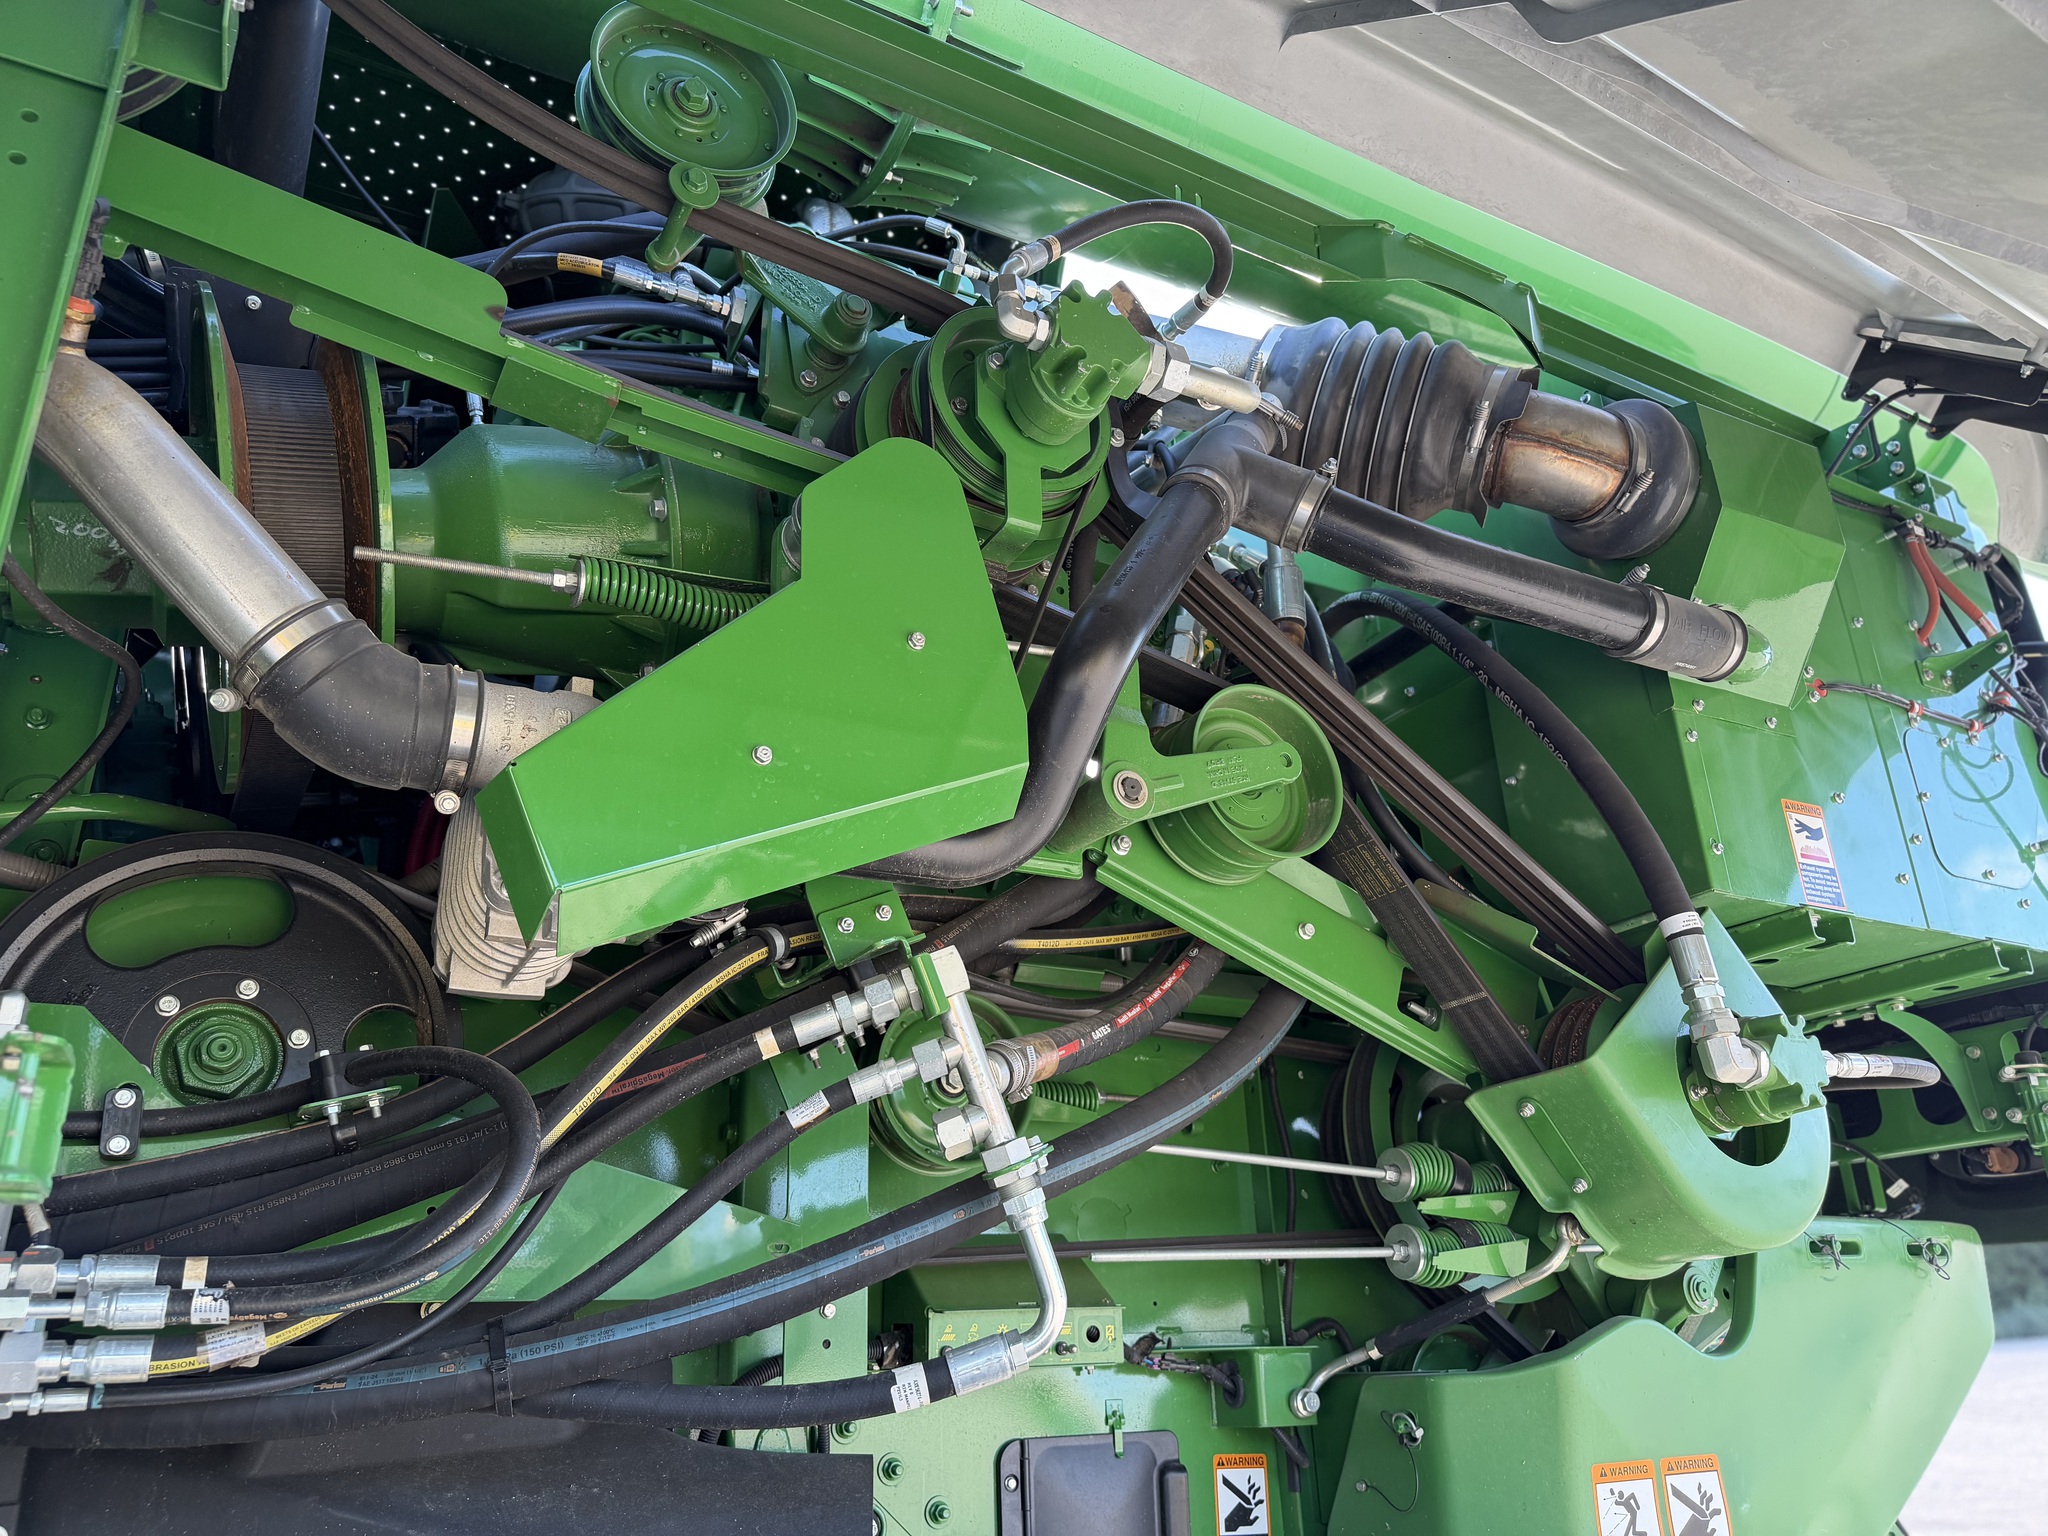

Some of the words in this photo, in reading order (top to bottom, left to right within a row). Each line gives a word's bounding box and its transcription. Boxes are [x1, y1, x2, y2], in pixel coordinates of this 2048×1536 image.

[1672, 615, 1692, 632] AIR
[1698, 623, 1732, 644] FLOW
[1494, 686, 1525, 719] MSHA
[1791, 803, 1822, 816] WARNING
[1361, 848, 1376, 867] JOHN
[1375, 867, 1392, 889] DEERE
[1372, 843, 1387, 862] JOHN
[1385, 862, 1402, 884] DEERE
[1036, 939, 1060, 948] T4012D
[1091, 1023, 1111, 1040] GATES
[571, 1084, 604, 1117] T4012D
[643, 1030, 659, 1045] MAX
[656, 1021, 668, 1033] WP
[674, 1002, 690, 1016] BAR
[689, 989, 705, 1004] 4100
[701, 982, 714, 994] PSI
[714, 969, 731, 984] MSHA
[406, 1148, 423, 1160] ISO
[342, 1169, 362, 1183] 4SH
[515, 1162, 536, 1198] Resistant
[297, 1178, 336, 1198] Exceeds
[501, 1195, 520, 1220] MSHA
[196, 1218, 216, 1232] SAE
[476, 1216, 504, 1245] 2G-11C
[155, 1225, 195, 1246] 100R15
[863, 1242, 886, 1256] Parker
[383, 1279, 420, 1298] POWERING
[274, 1328, 292, 1339] MEETS
[148, 1359, 195, 1372] BRASION
[318, 1379, 347, 1391] Parker
[519, 1345, 542, 1359] (150
[542, 1339, 565, 1354] PSI)
[1225, 1456, 1264, 1466] WARNING
[1674, 1457, 1714, 1471] WARNING
[1609, 1464, 1648, 1477] WARNING
